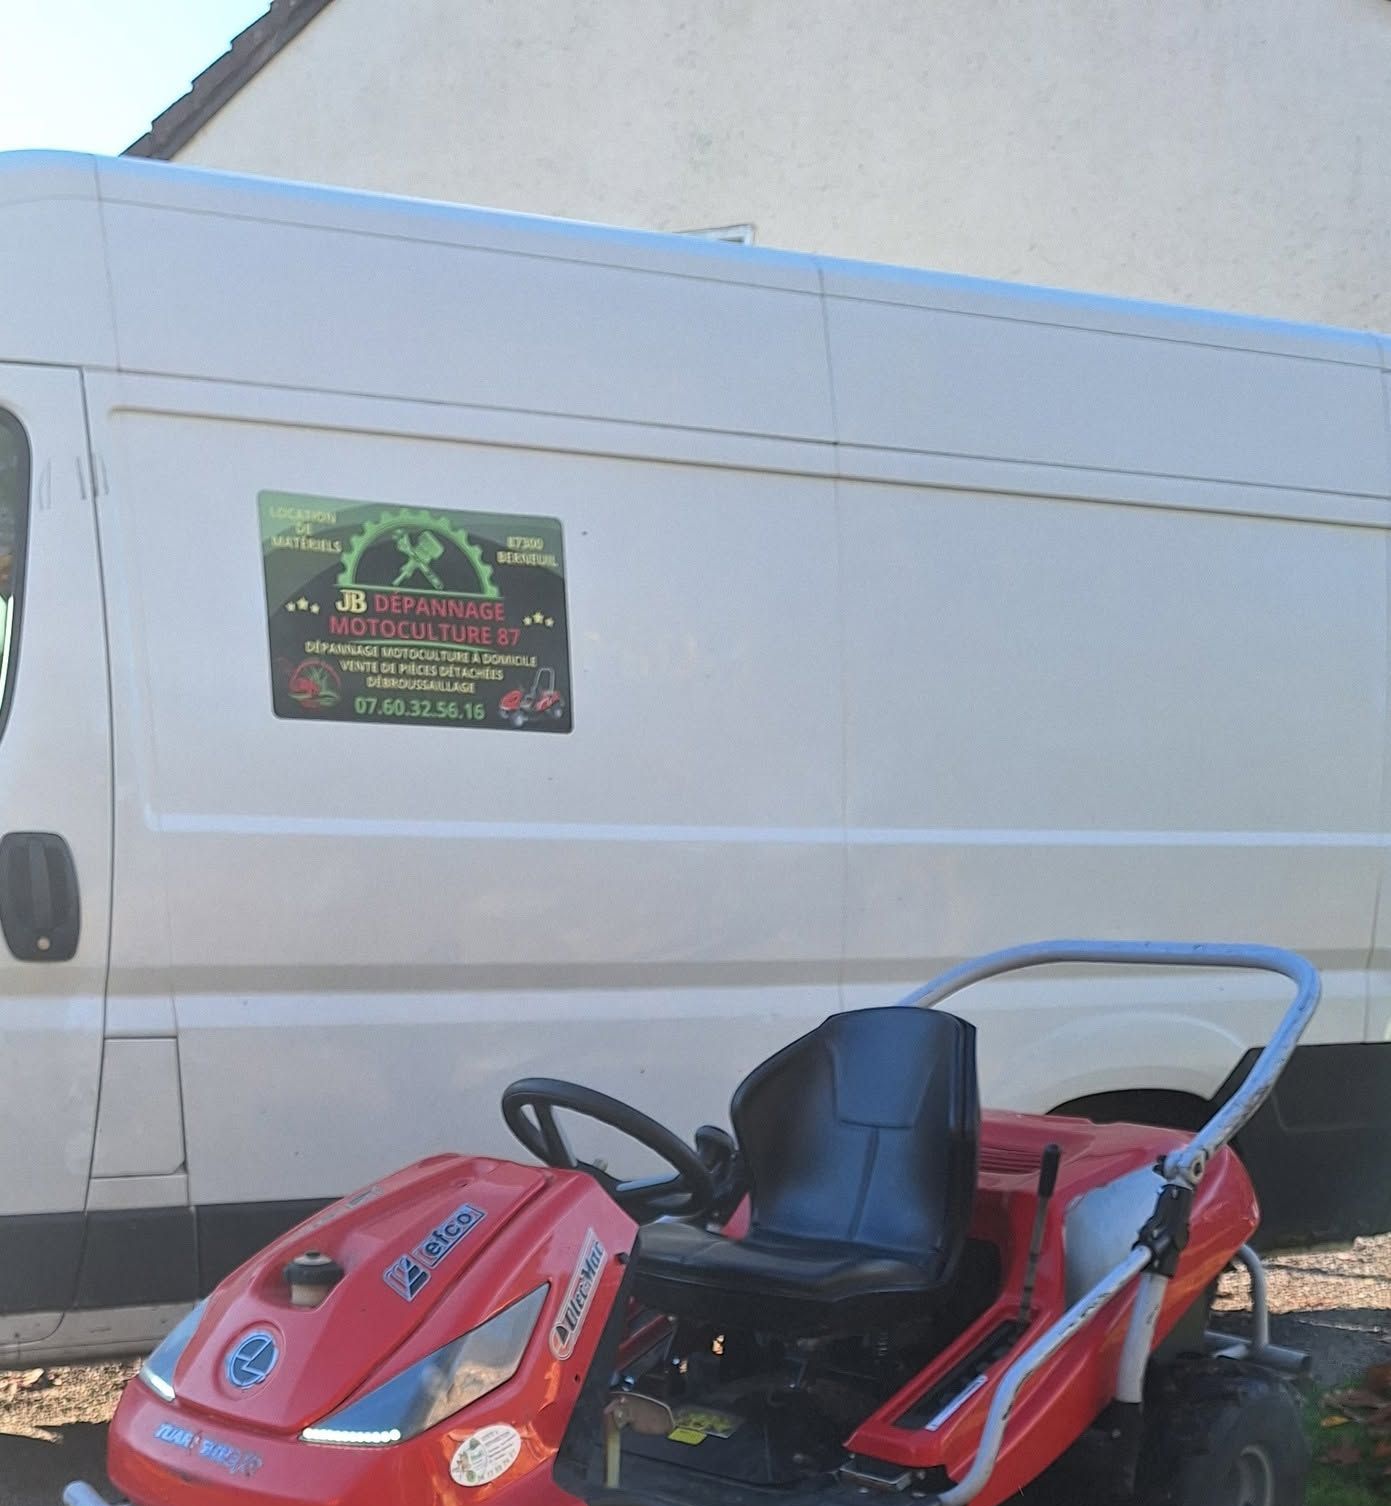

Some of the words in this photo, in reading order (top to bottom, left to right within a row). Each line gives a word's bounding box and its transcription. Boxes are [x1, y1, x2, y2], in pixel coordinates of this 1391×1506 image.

[335, 589, 367, 613] JB
[374, 592, 505, 621] DÉPANNAGE
[328, 615, 492, 645] MOTOCULTURE
[496, 628, 520, 646] 87
[304, 640, 378, 657] DÉPANNAGE
[380, 646, 470, 664] MOTOCULTURE
[482, 654, 538, 667] DOMICILE
[339, 658, 378, 673] VENTE
[380, 663, 396, 675] DE
[438, 665, 504, 681] DÉTACHÉES
[366, 674, 476, 694] DÉBROUSSAILLAGE
[354, 697, 486, 721] 07.60.32.56.16
[425, 1211, 473, 1257] efco
